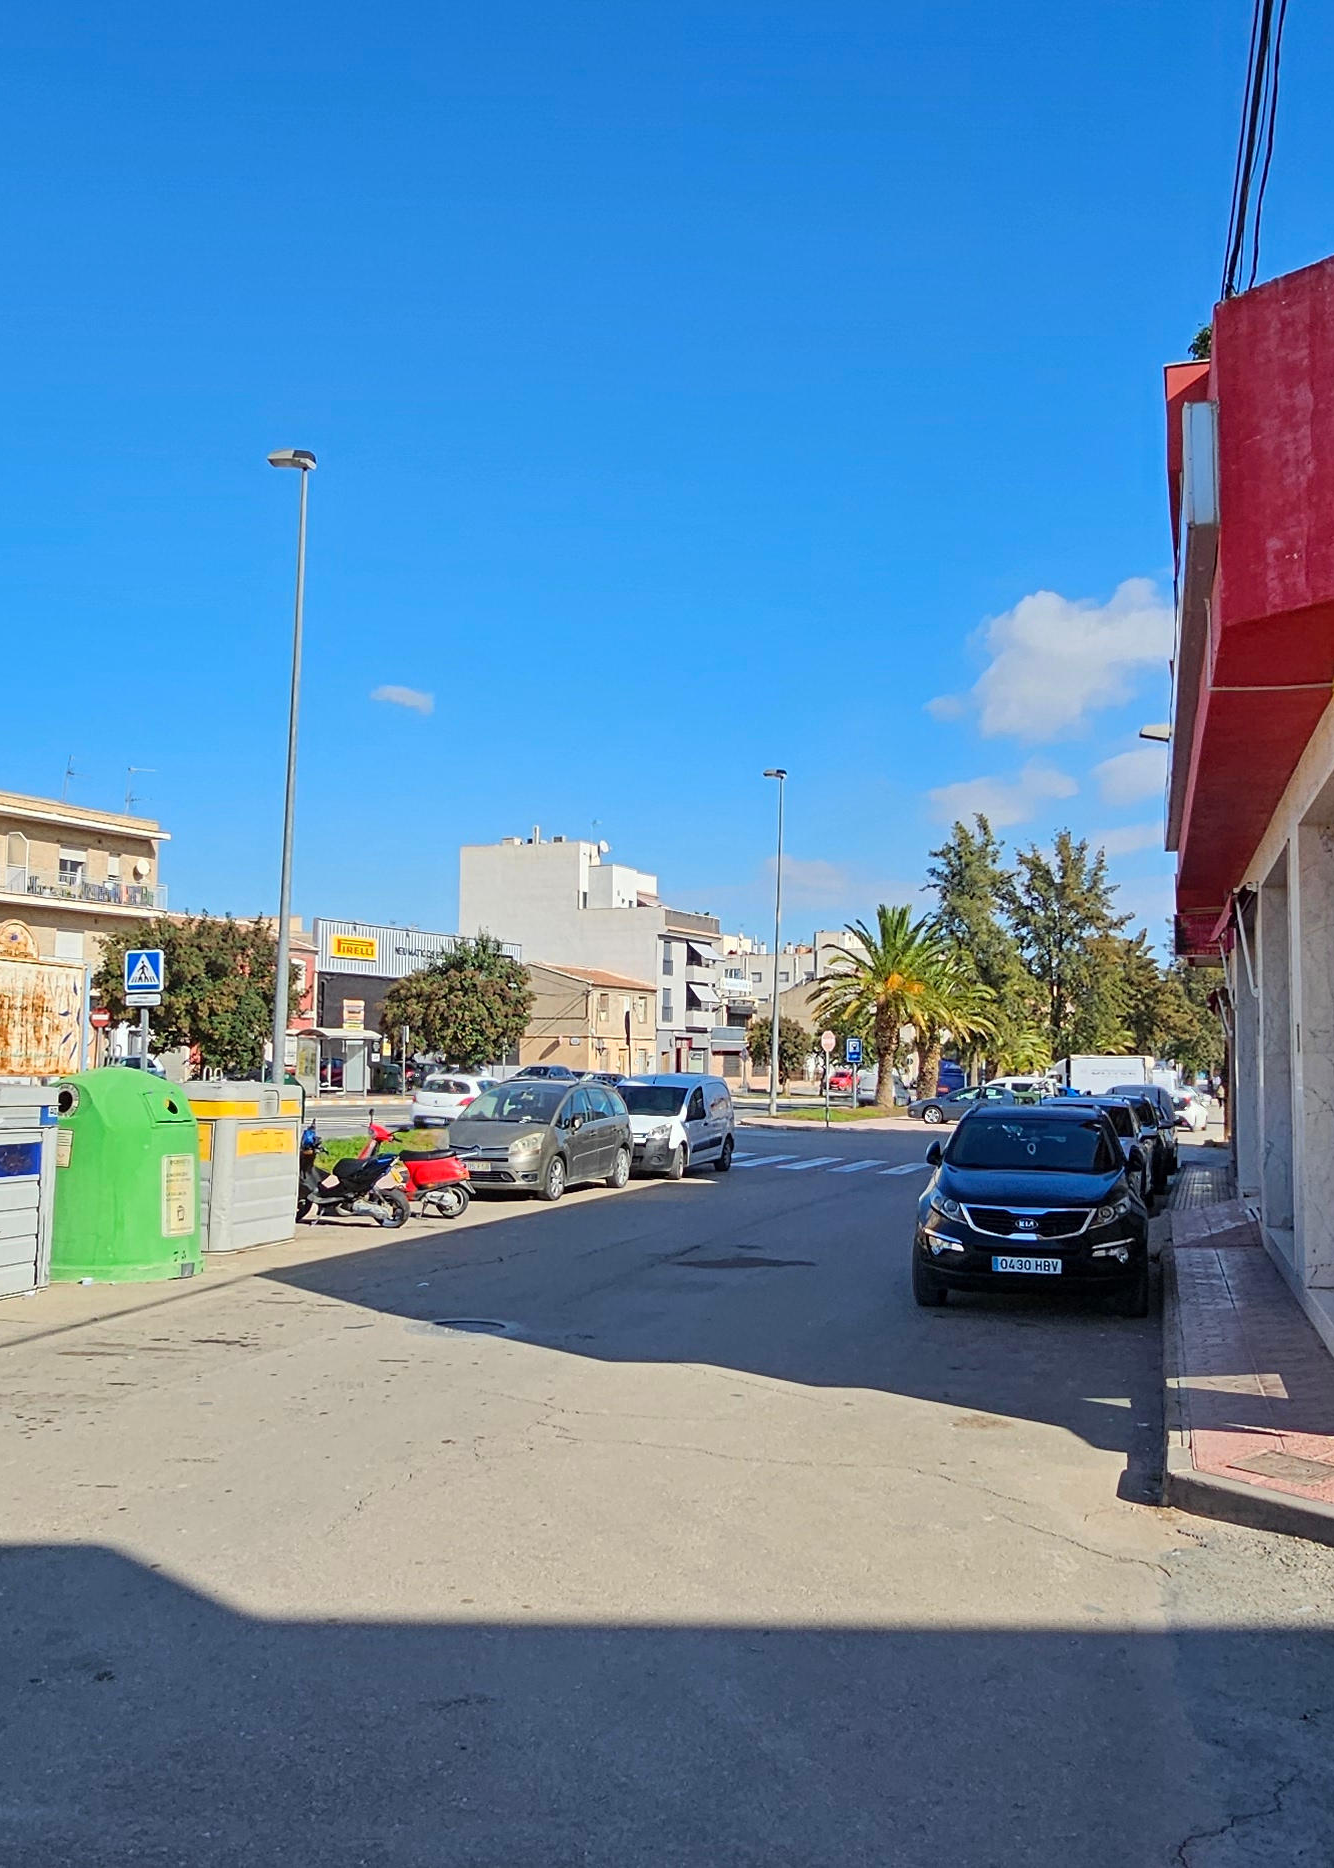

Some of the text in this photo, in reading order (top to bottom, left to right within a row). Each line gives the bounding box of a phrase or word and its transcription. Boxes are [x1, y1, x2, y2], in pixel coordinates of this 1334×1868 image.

[337, 938, 374, 956] PIRELLI
[1000, 1258, 1059, 1272] 0430 HBV
